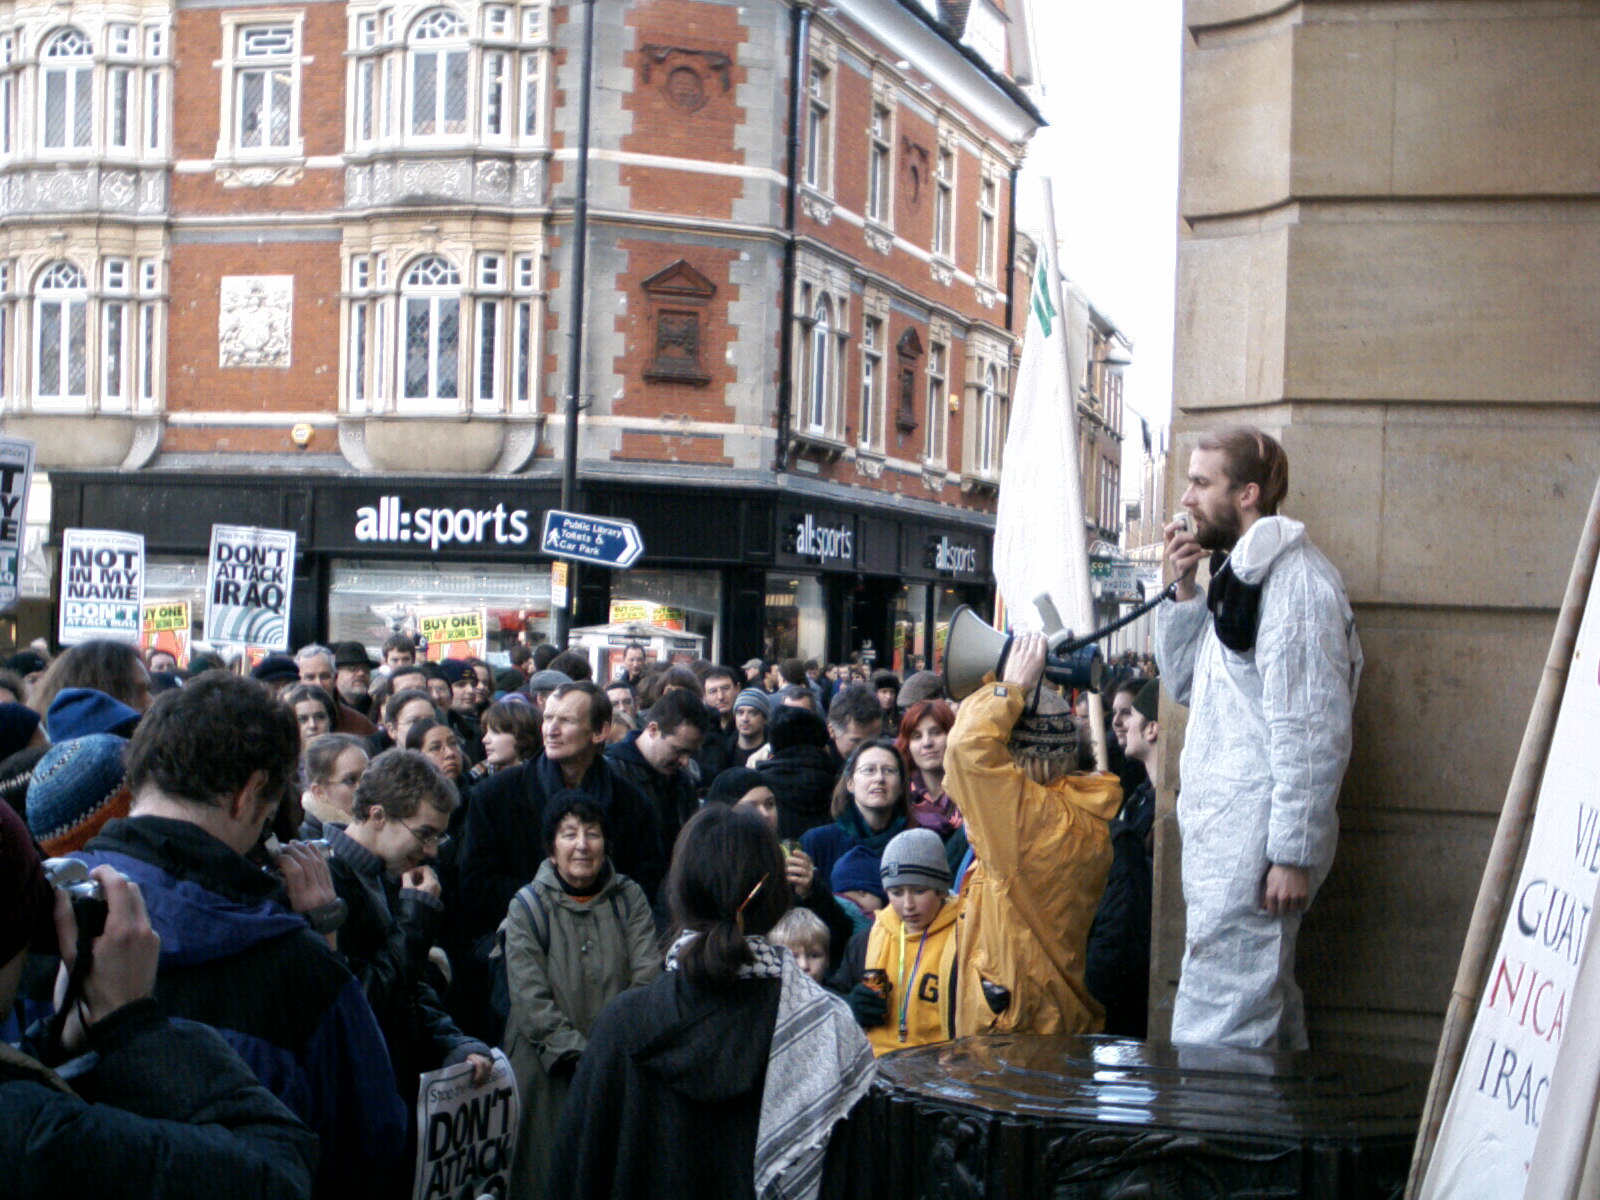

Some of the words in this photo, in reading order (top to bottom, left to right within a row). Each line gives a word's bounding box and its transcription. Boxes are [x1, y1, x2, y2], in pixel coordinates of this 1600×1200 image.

[355, 496, 528, 550] all:sports
[563, 518, 590, 531] Public
[592, 524, 623, 539] Library
[559, 540, 576, 550] Car
[579, 544, 600, 555] Park
[561, 529, 592, 543] Toilets
[594, 534, 604, 545] &
[796, 513, 852, 565] all:sports
[70, 547, 138, 569] NOT
[217, 543, 286, 566] DON'T
[935, 536, 976, 577] all:sports
[68, 568, 92, 583] IN
[100, 569, 137, 585] MY
[216, 562, 284, 583] ATTACK
[68, 583, 138, 600] NAME
[214, 580, 284, 614] IRAQ
[66, 603, 137, 619] DON'T
[159, 606, 183, 617] ONE
[66, 618, 107, 627] ATTACK
[424, 618, 447, 630] BUY
[451, 615, 477, 627] ONE
[427, 1086, 512, 1162] DON'T
[425, 1133, 511, 1200] ATTACK
